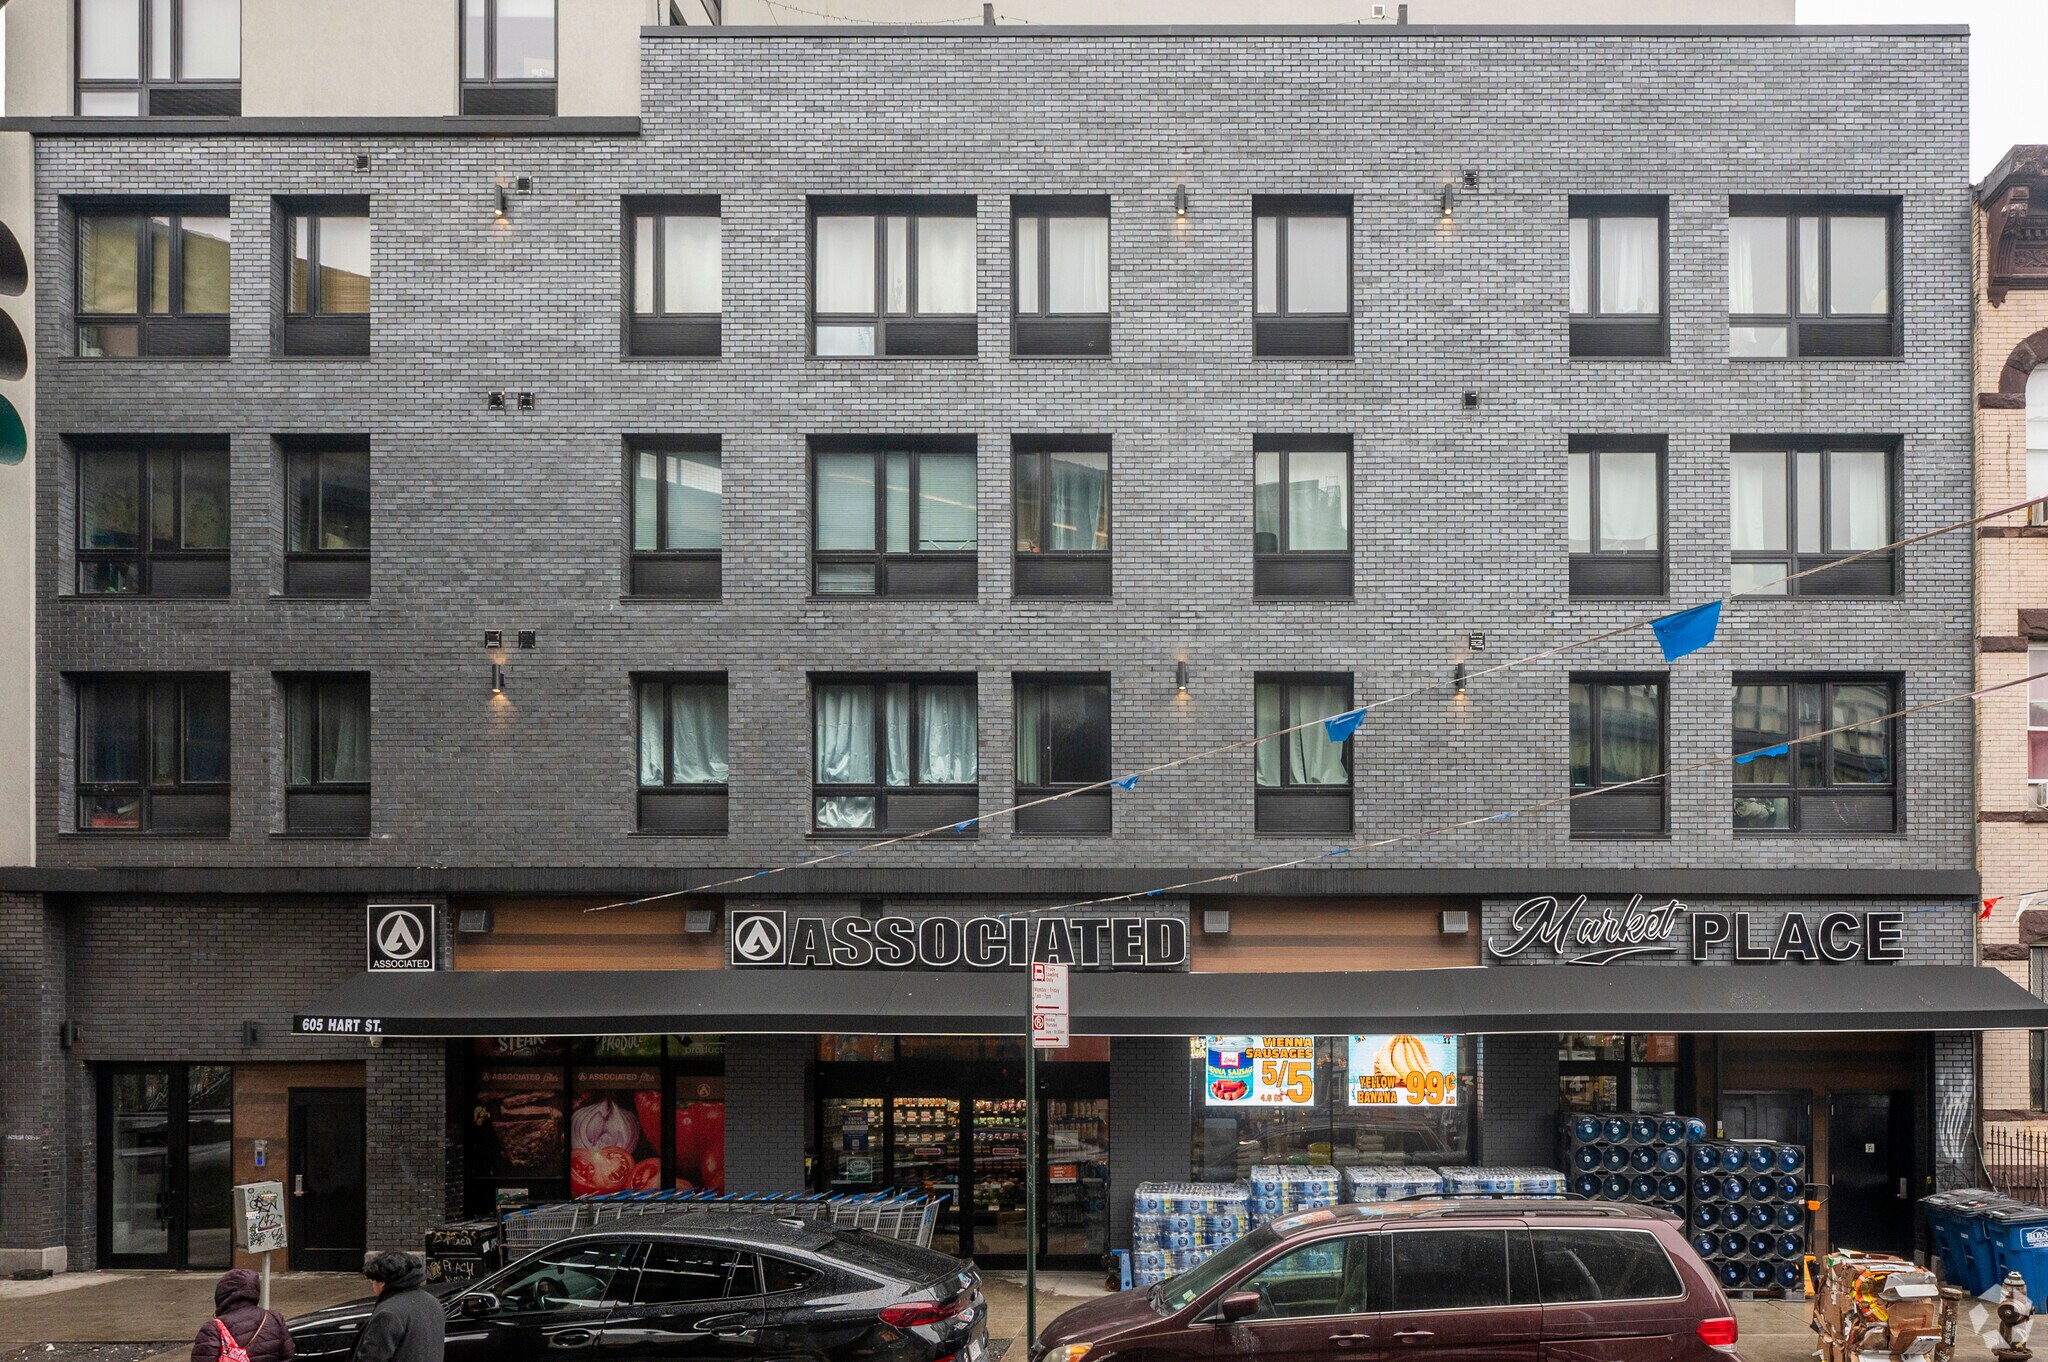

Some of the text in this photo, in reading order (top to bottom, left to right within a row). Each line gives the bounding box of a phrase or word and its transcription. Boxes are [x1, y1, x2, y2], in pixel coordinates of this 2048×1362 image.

[1489, 893, 1905, 961] Market PLACE
[788, 916, 1187, 967] ASSOCIATED
[373, 960, 430, 968] ASSOCIATED
[302, 1018, 382, 1032] 605 HART ST.
[1262, 1037, 1313, 1048] VIENNA
[1245, 1048, 1313, 1059] SAUSAGES
[492, 1073, 541, 1081] ASSOCIATED
[588, 1073, 638, 1081] ASSOCIATED
[1261, 1060, 1313, 1103] 5/5
[1359, 1076, 1396, 1089] YELLOW
[1357, 1091, 1398, 1104] BANANA
